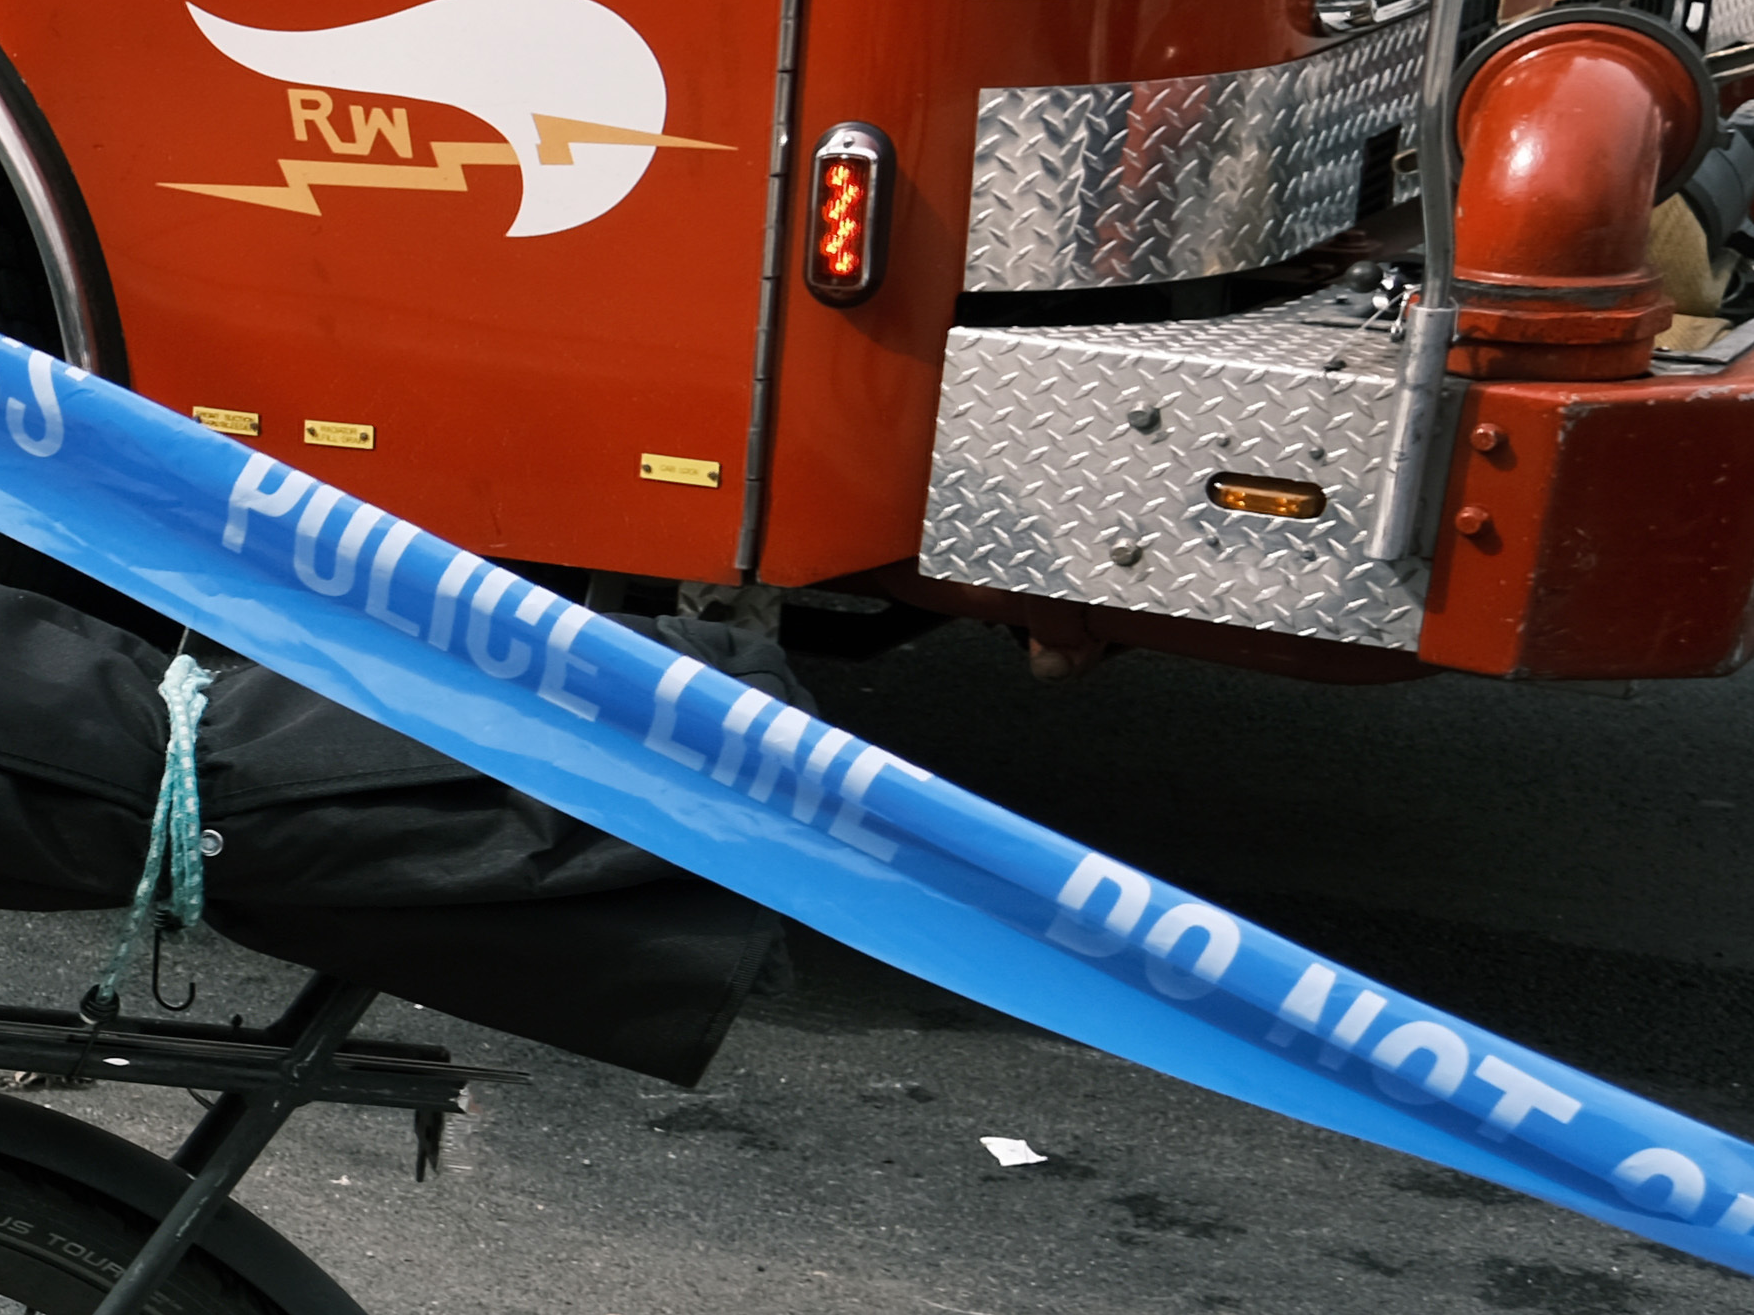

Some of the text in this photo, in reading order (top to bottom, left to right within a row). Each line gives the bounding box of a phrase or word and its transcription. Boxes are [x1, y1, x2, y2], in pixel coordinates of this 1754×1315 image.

[287, 88, 413, 160] RW
[221, 451, 935, 864] POLICE LINE
[1045, 851, 1583, 1145] DO NOT
